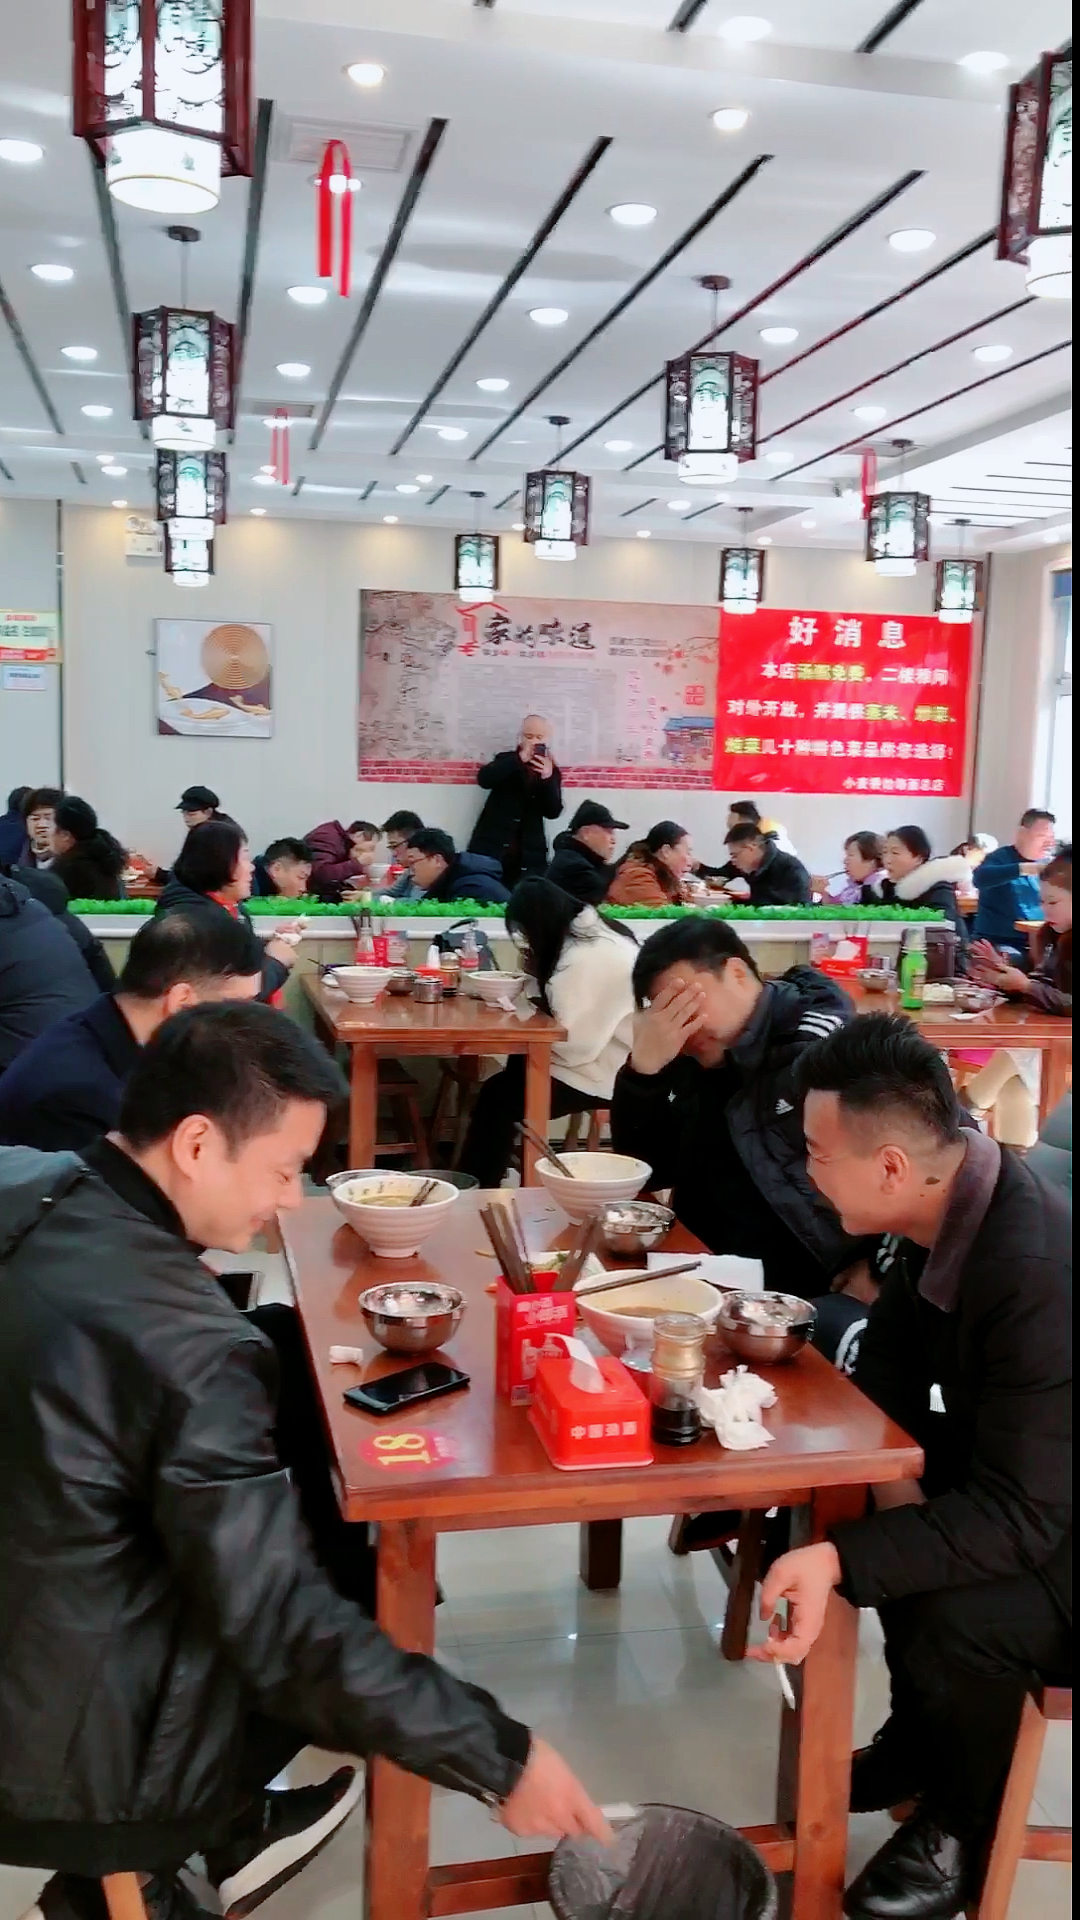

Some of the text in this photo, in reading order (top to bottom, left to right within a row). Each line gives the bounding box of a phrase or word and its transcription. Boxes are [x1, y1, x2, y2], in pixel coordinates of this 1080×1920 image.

[789, 616, 906, 648] 好消息
[373, 1433, 431, 1465] 18
